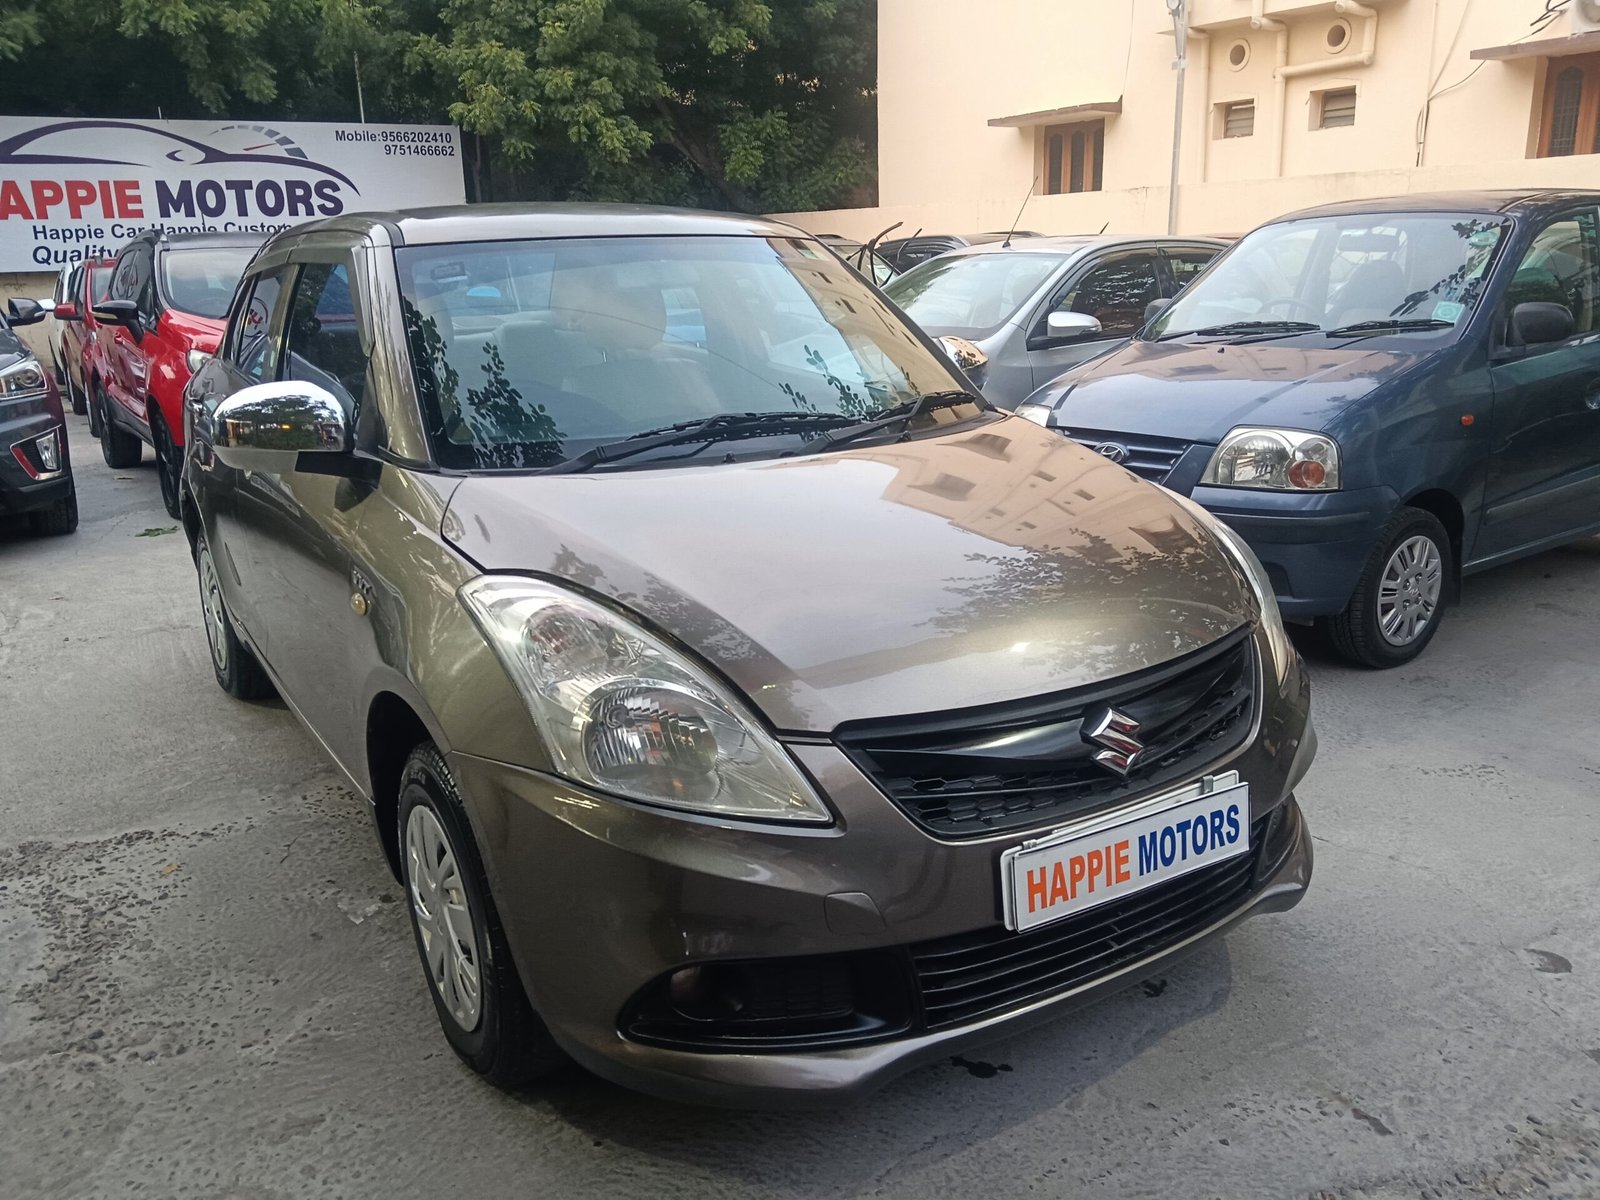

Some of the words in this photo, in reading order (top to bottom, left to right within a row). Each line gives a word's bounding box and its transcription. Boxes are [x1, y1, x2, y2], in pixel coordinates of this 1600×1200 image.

[384, 144, 455, 156] 9751466662
[155, 179, 344, 218] MOTORS
[32, 224, 104, 243] Happie
[111, 223, 145, 238] Car
[1027, 840, 1130, 912] HAPPIE
[1138, 804, 1240, 876] MOTORS
